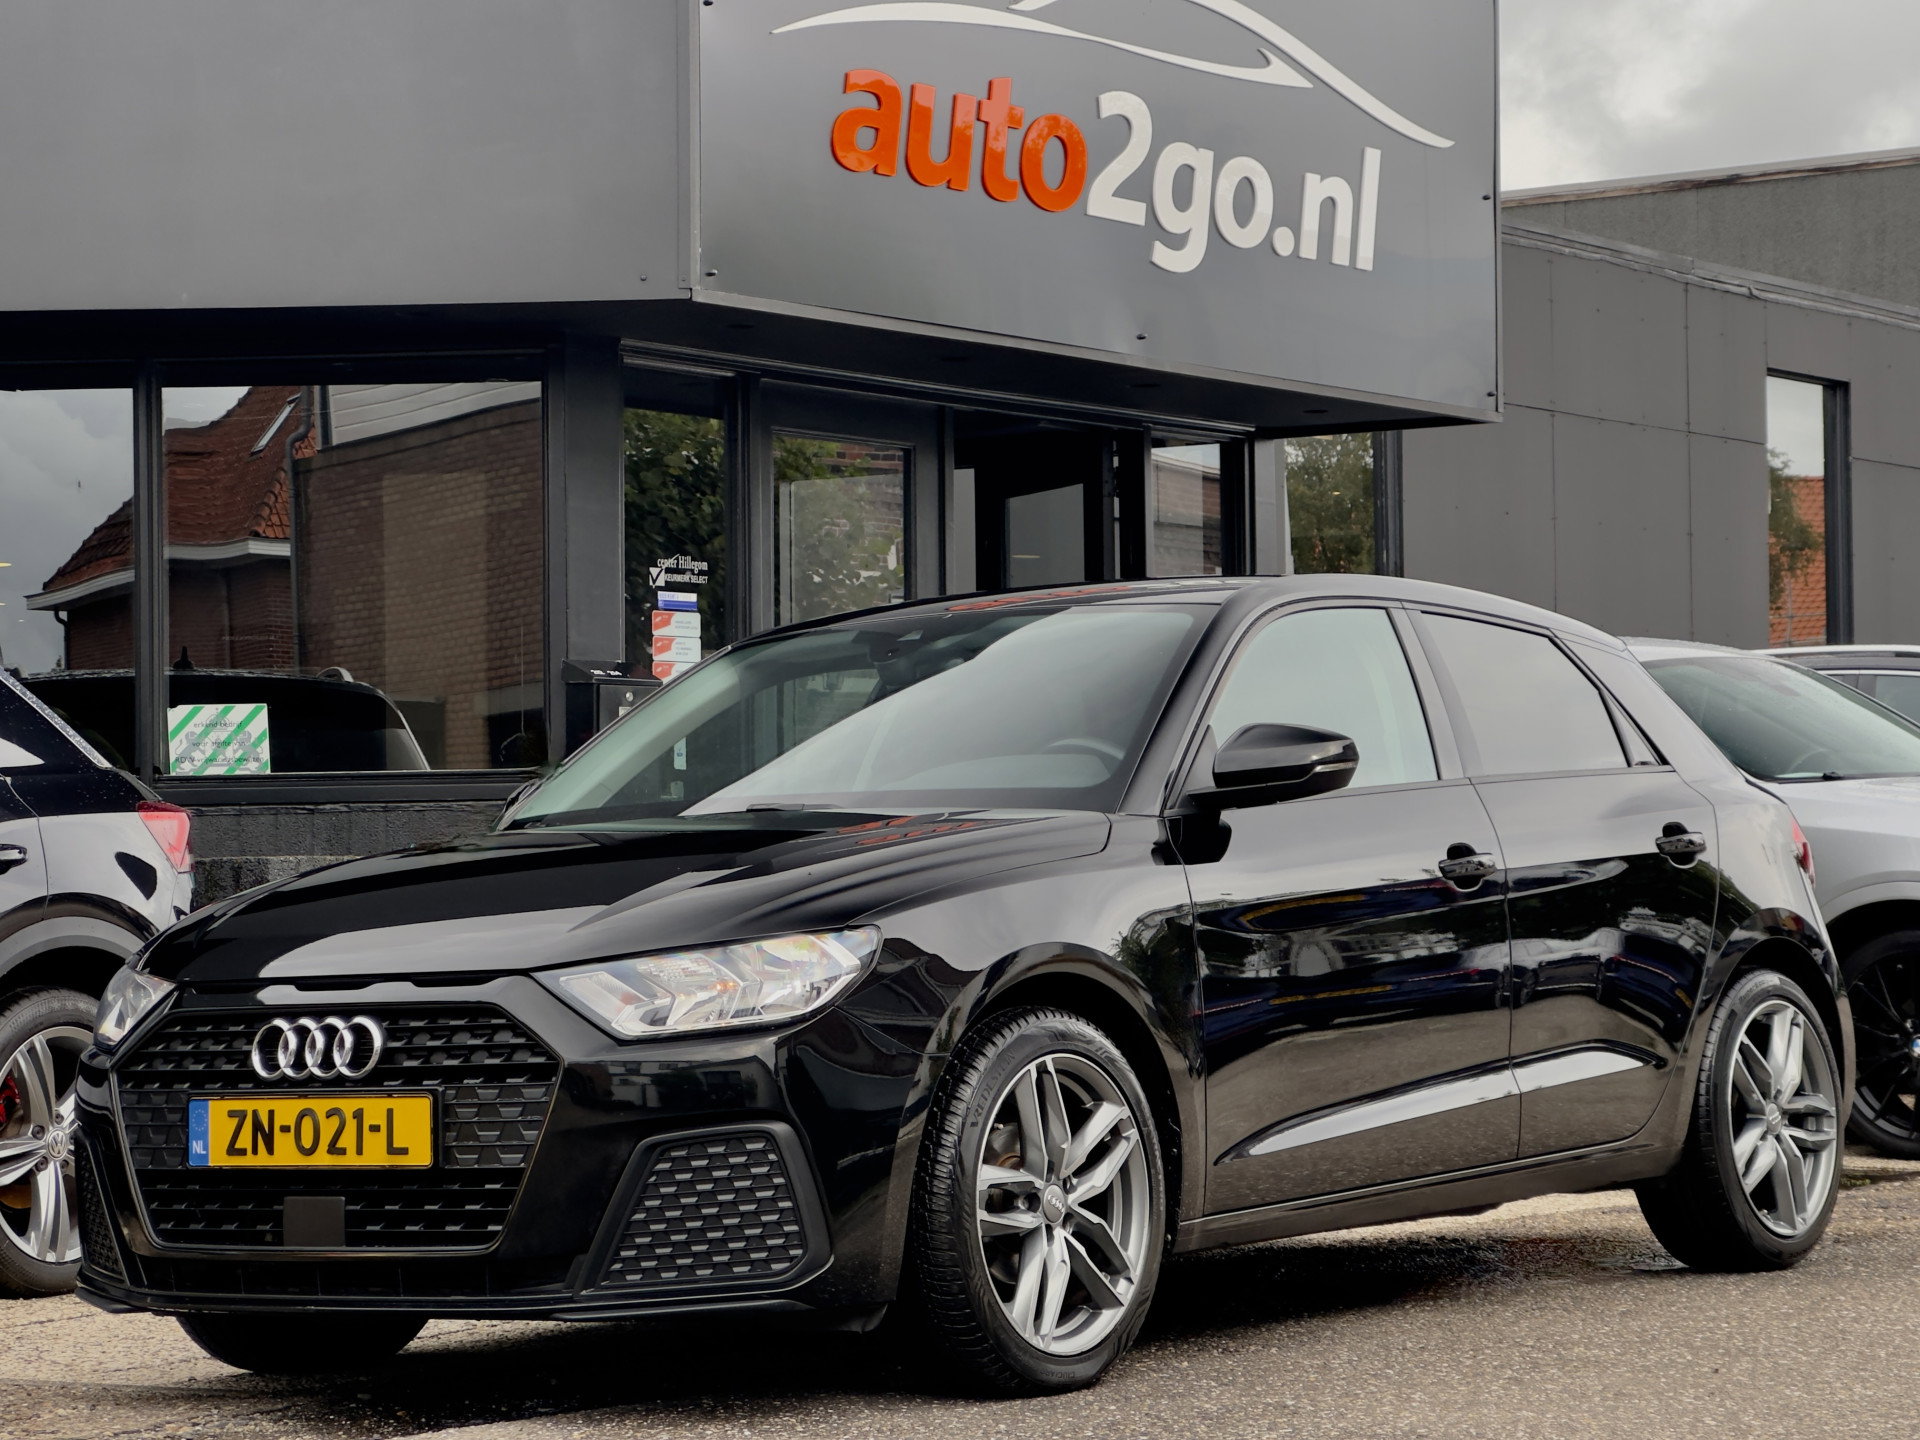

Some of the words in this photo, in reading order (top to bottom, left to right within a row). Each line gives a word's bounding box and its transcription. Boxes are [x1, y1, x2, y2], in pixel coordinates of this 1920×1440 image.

[830, 69, 1382, 273] auto2go.nl
[678, 555, 708, 574] Hillegom
[664, 573, 691, 583] KEURMERK
[691, 575, 708, 584] SELECT
[226, 1107, 409, 1156] ZN-021-L
[192, 1140, 207, 1155] NL
